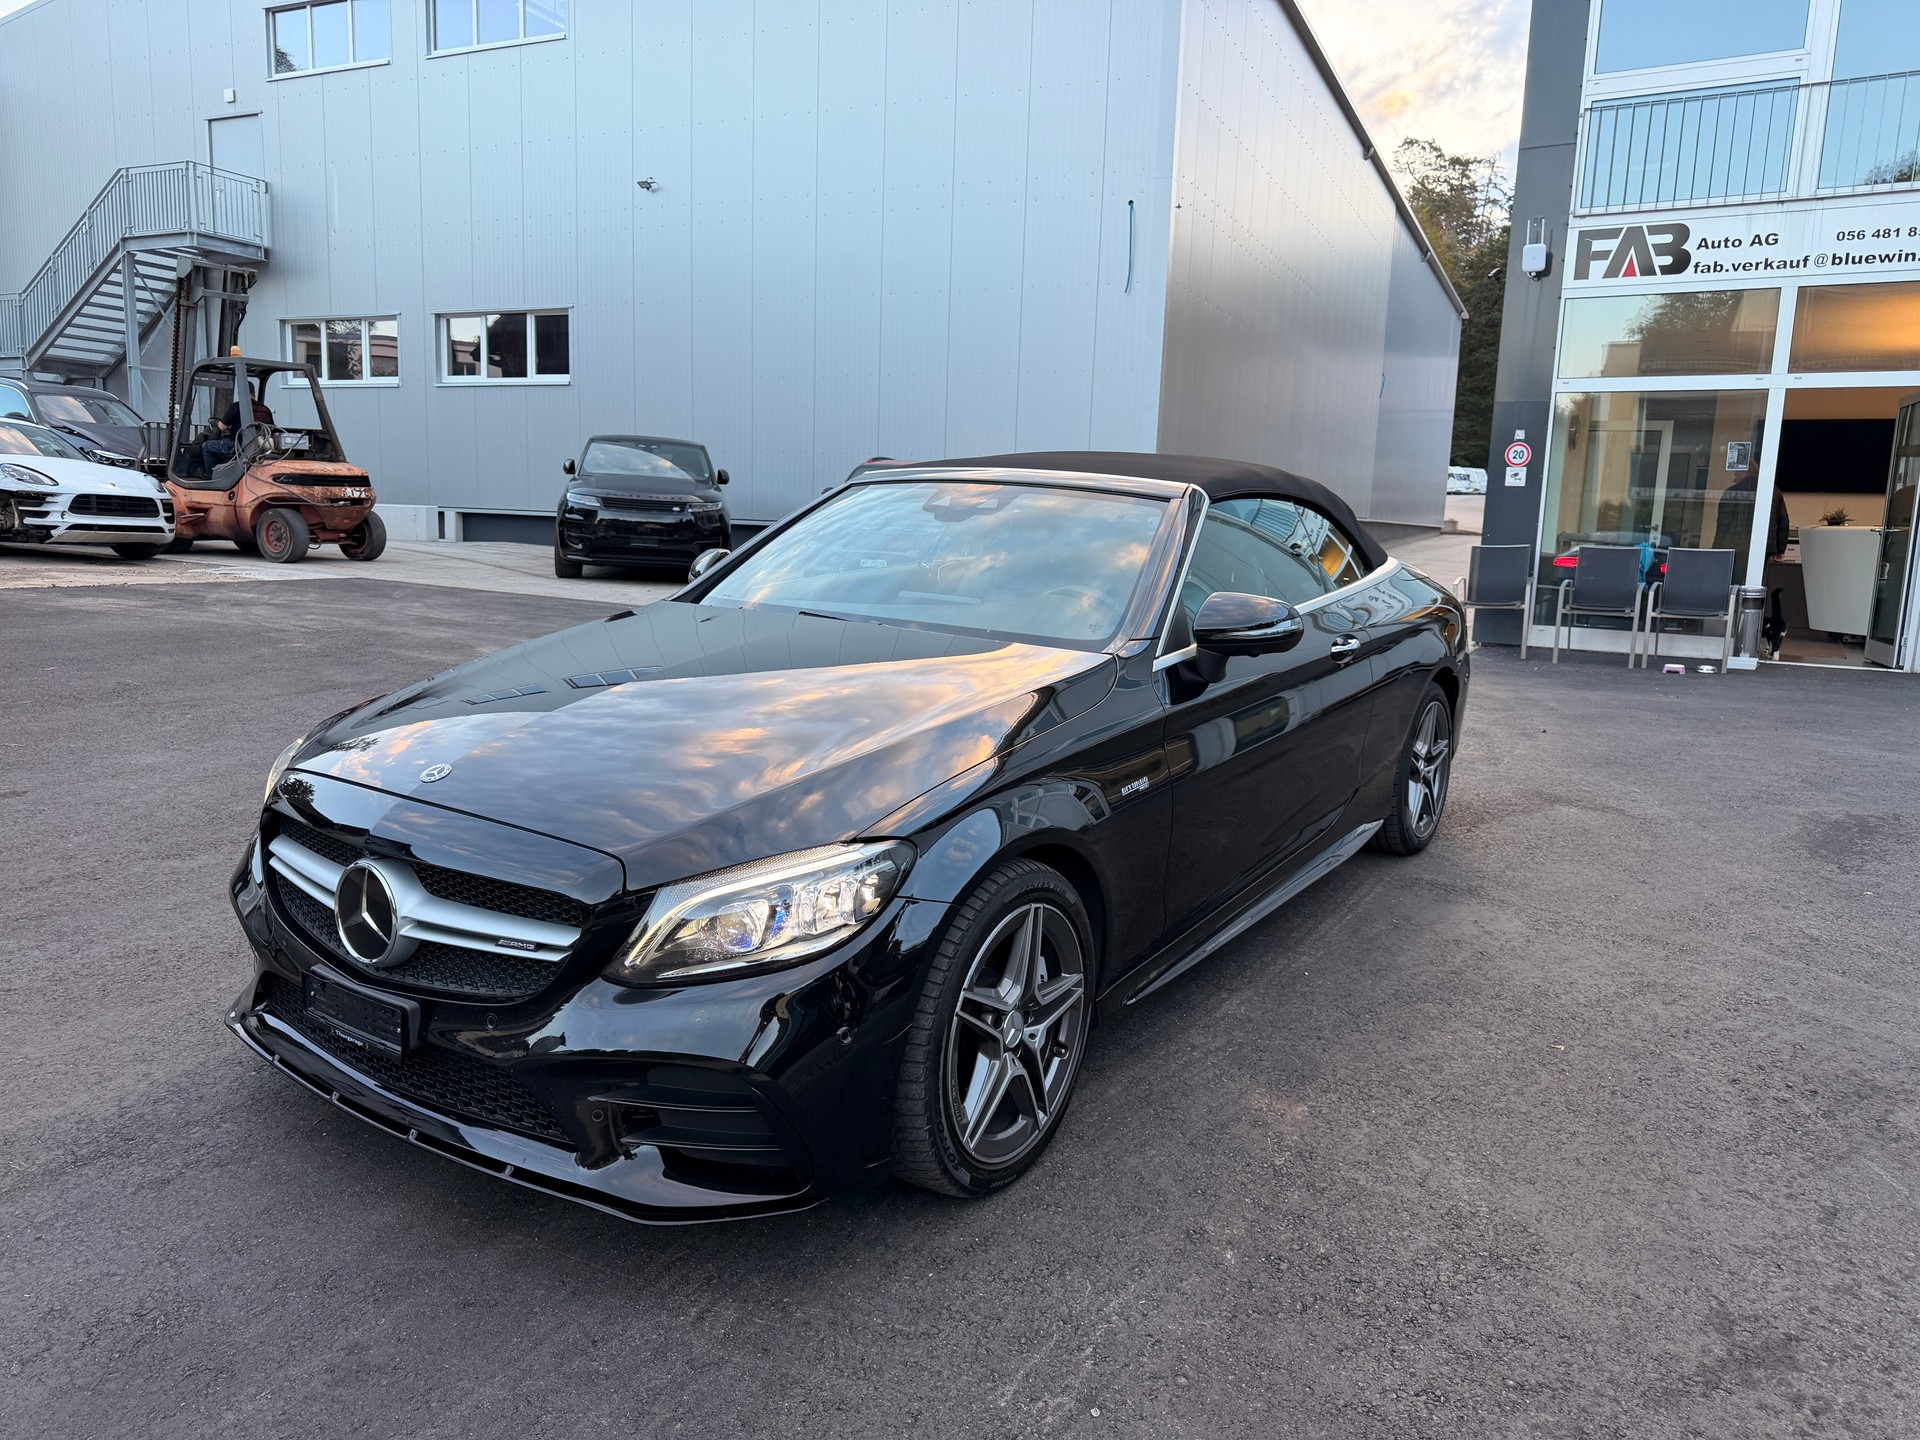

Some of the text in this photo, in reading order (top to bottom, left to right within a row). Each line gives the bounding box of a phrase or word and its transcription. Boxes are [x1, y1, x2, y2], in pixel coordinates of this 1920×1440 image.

[1836, 226, 1920, 241] 056 481 8
[1696, 233, 1779, 250] Auto AG
[1573, 223, 1692, 280] FAB
[1512, 449, 1525, 460] 20
[508, 941, 535, 949] AMG
